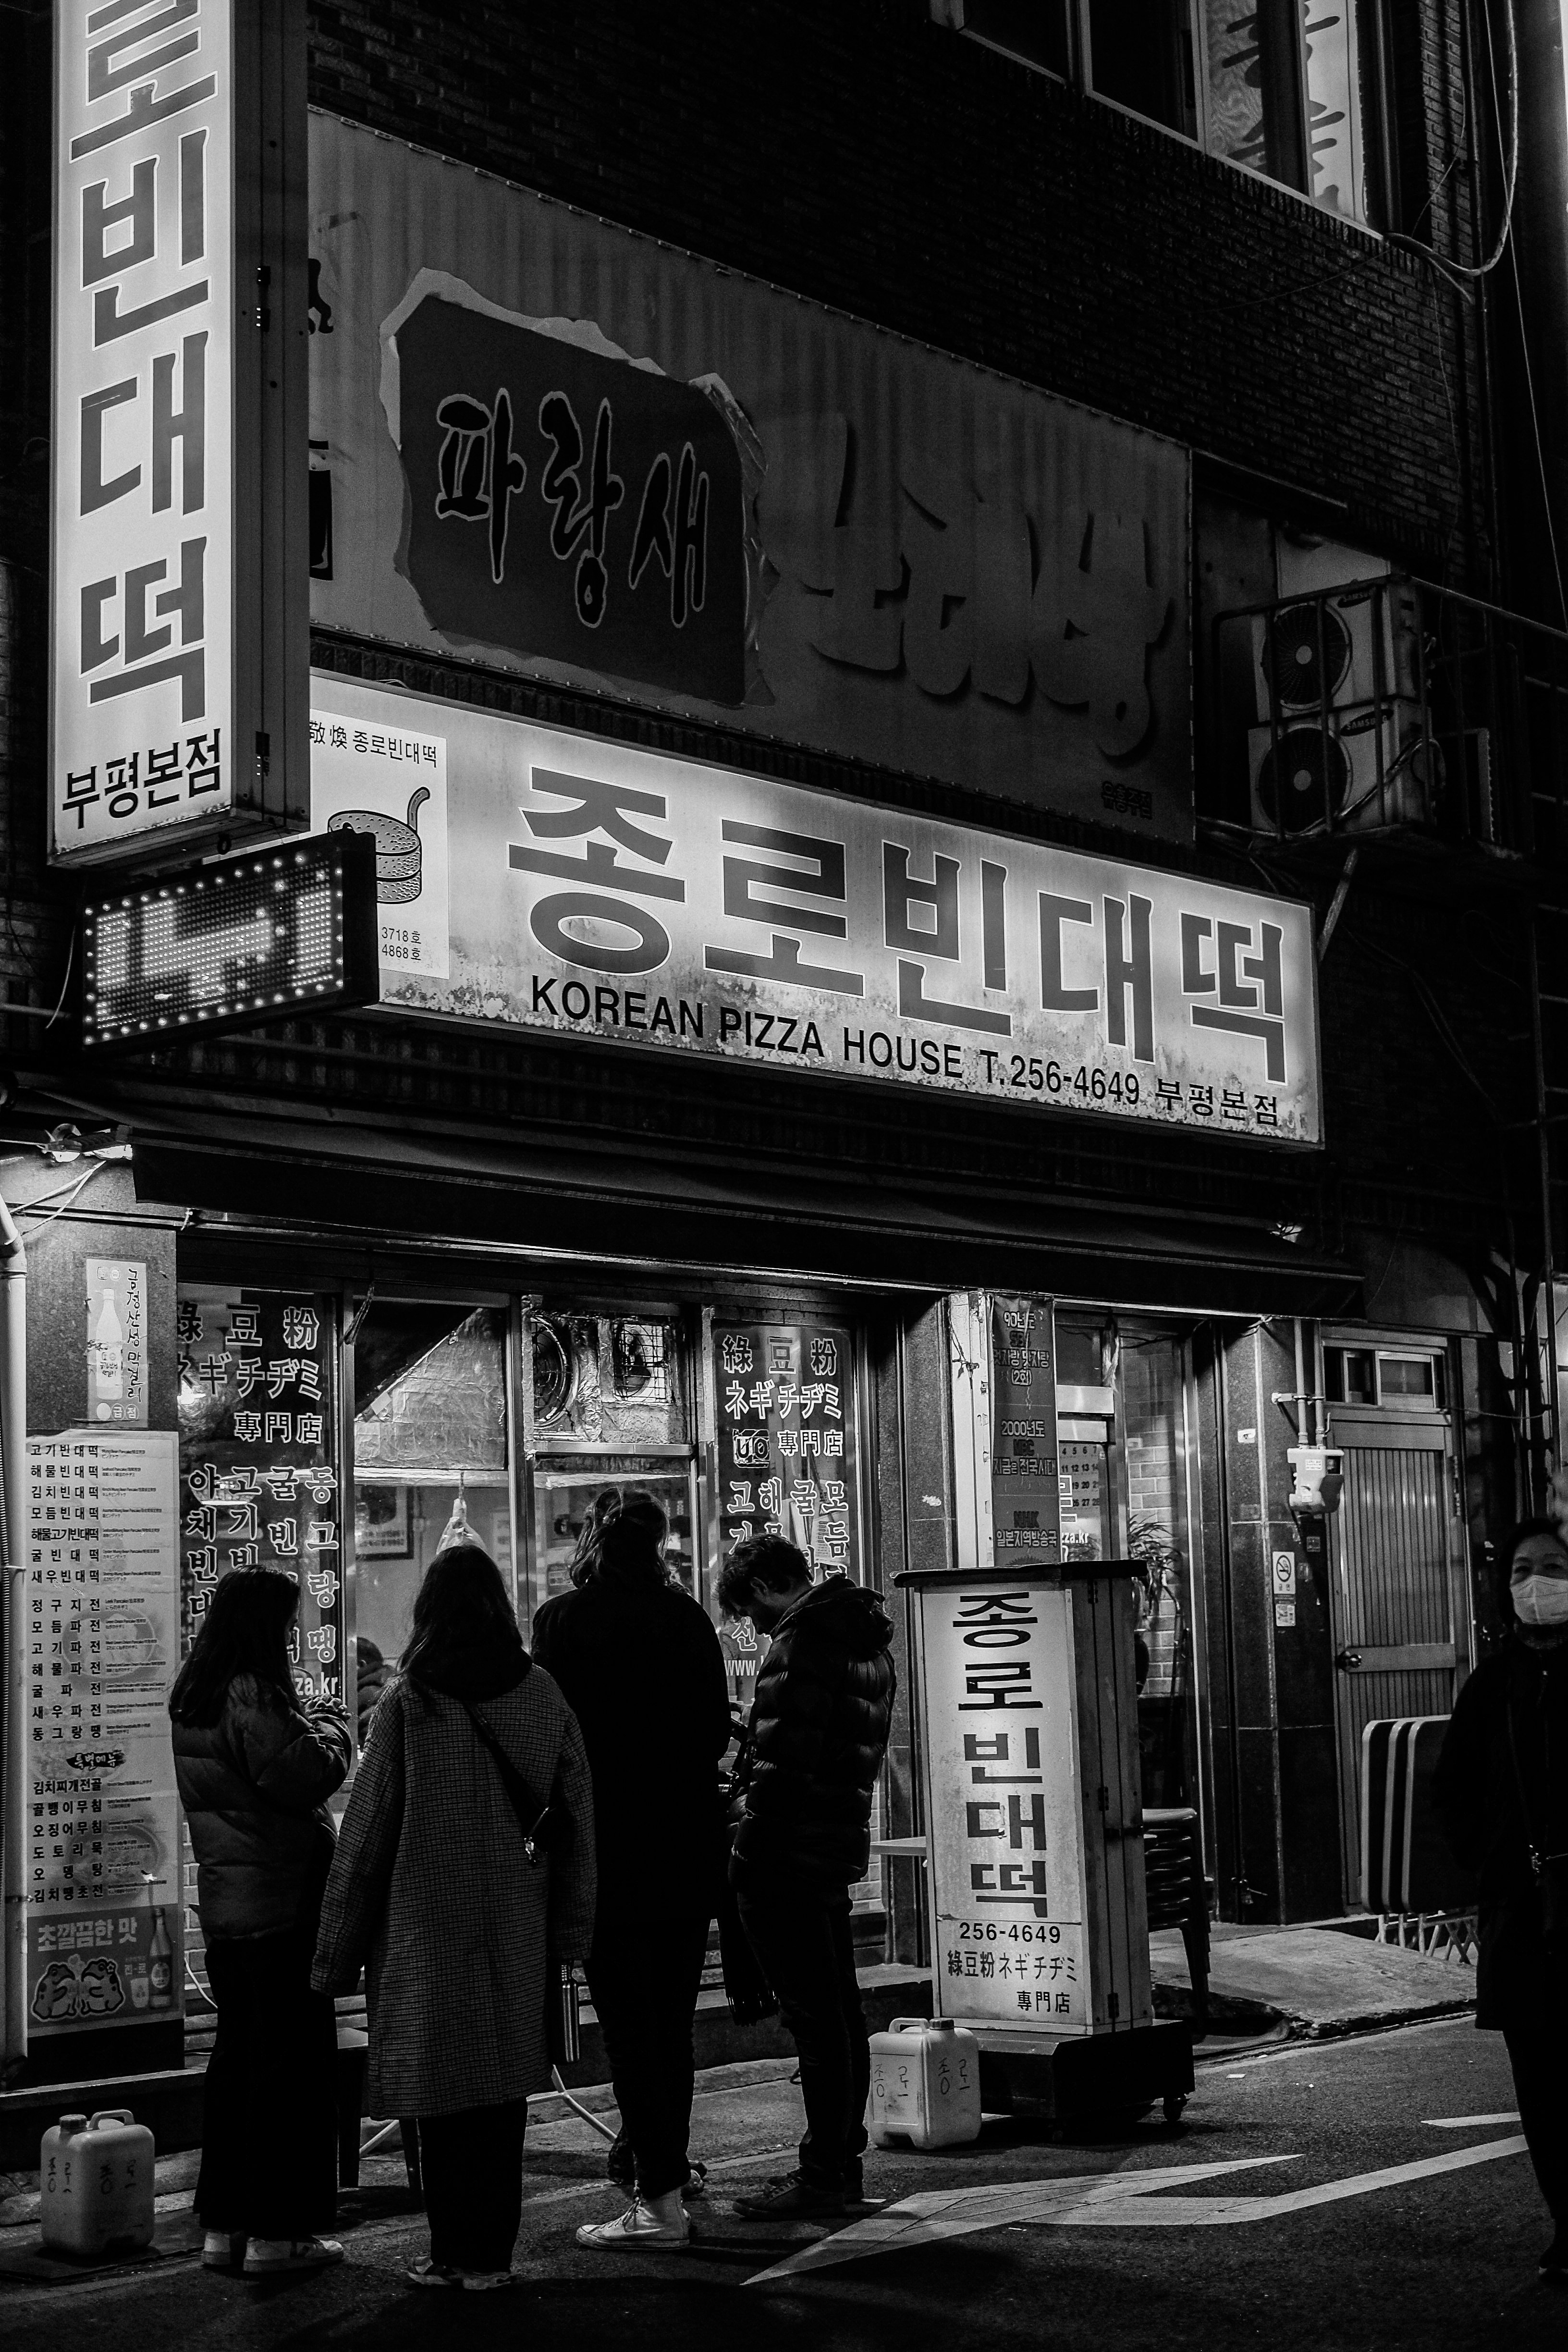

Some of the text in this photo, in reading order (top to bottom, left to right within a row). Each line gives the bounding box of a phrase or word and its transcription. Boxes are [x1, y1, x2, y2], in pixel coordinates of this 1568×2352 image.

[436, 387, 709, 628] 파랑새
[353, 730, 437, 768] 종로빈대떡
[62, 728, 222, 830] 부평본점
[507, 764, 1288, 1086] 종로빈대떡
[381, 927, 422, 944] 3718호
[381, 944, 421, 961] 4868호
[532, 975, 704, 1039] KOREAN
[720, 1006, 825, 1057] PIZZA
[843, 1026, 962, 1079] HOUSE
[1154, 1078, 1279, 1127] 부평본점
[724, 1379, 842, 1420] ネギチヂミ
[233, 1410, 323, 1444] 專門店
[1001, 1419, 1045, 1437] 2000년도
[31, 1444, 98, 1458] 고기빈대떡
[777, 1429, 843, 1457] 專門店
[1061, 1447, 1067, 1455] 4
[1072, 1446, 1077, 1455] 5
[31, 1465, 98, 1479] 해물빈대떡
[31, 1486, 98, 1499] 김치빈대떡
[31, 1507, 99, 1520] 모듬빈대떡
[1013, 1510, 1040, 1529] NHK
[31, 1528, 99, 1541] 해물고기빈대떡
[31, 1548, 99, 1562] 굴빈대떡
[31, 1569, 99, 1583] 새우빈대떡
[32, 1598, 100, 1613] 정구지전
[32, 1619, 100, 1633] 모듬파전
[32, 1640, 100, 1654] 고기파전
[32, 1661, 100, 1676] 해물파전
[724, 1655, 764, 1677] www.
[32, 1682, 101, 1698] 굴파전
[32, 1703, 101, 1719] 새우파전
[33, 1725, 101, 1741] 동그랑땡
[953, 1592, 1048, 1918] 종로빈대떡
[34, 1777, 102, 1795] 김치찌개전골
[33, 1799, 102, 1816] 골뱅이무침
[33, 1820, 102, 1838] 오징어무침
[38, 1917, 138, 1951] 초깔끔한 맛
[960, 1922, 1061, 1944] 256-4649
[1017, 1990, 1070, 2013] 專門店
